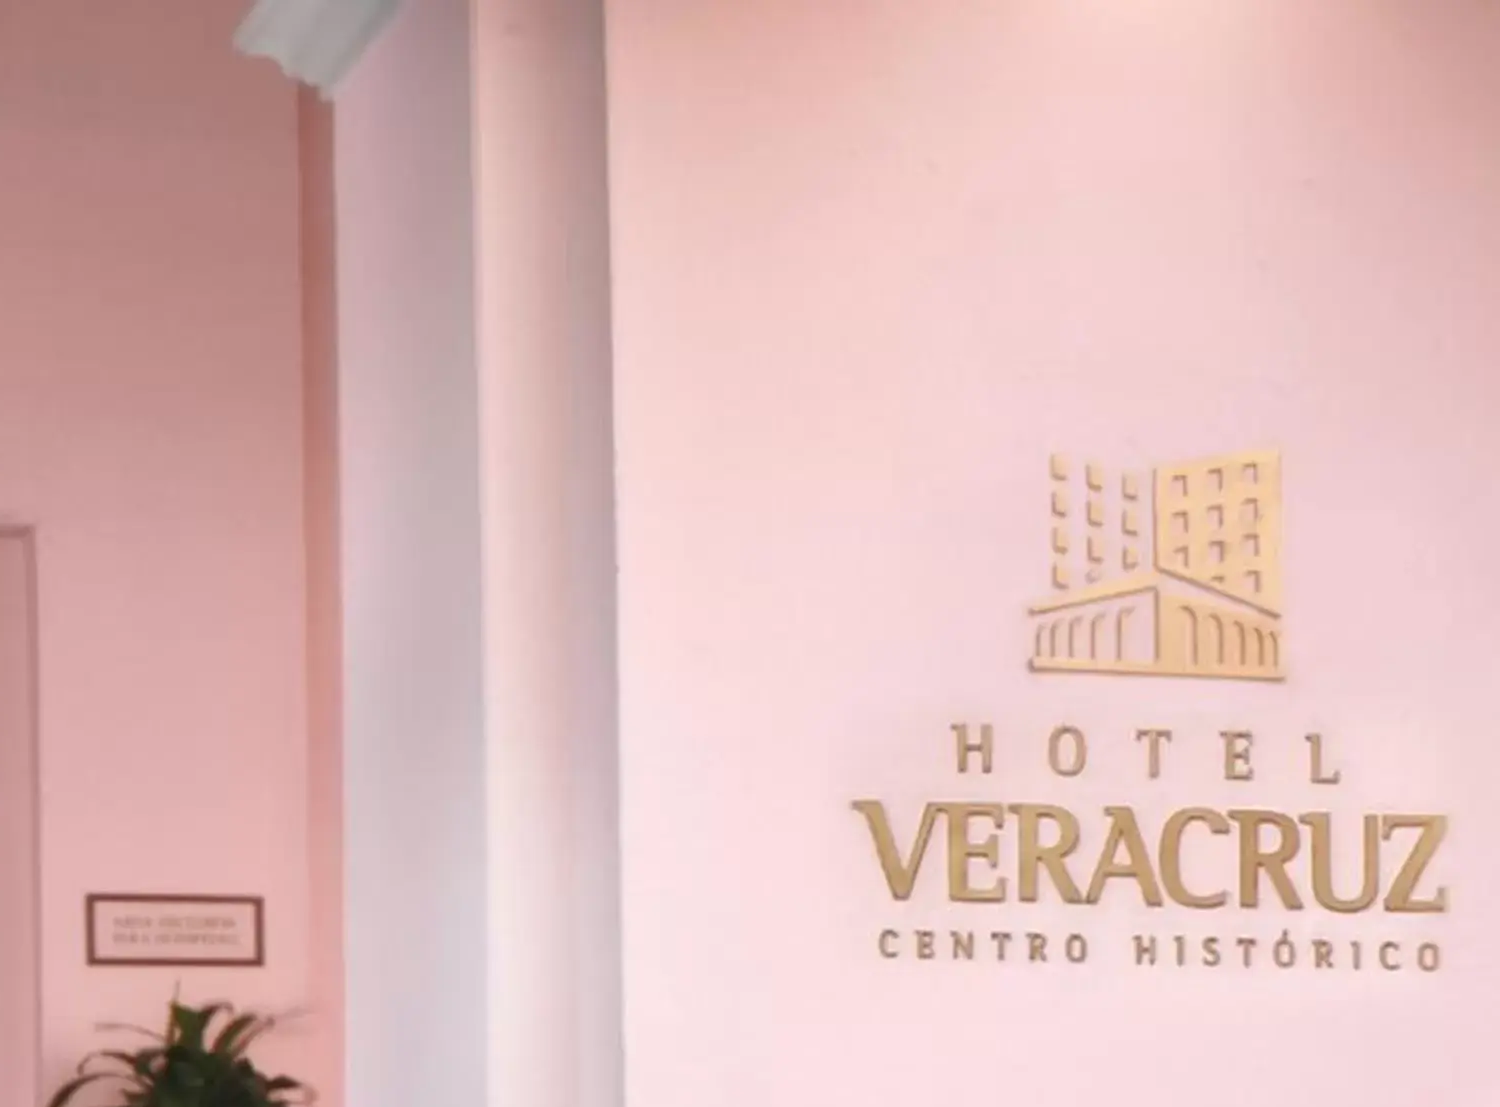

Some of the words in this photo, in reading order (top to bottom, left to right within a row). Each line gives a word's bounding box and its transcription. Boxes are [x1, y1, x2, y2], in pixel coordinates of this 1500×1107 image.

[949, 722, 1341, 786] HOTEL
[849, 799, 1450, 914] VERACRUZ
[877, 928, 1089, 965] CENTRO
[1132, 928, 1442, 973] HISTÓRICO
